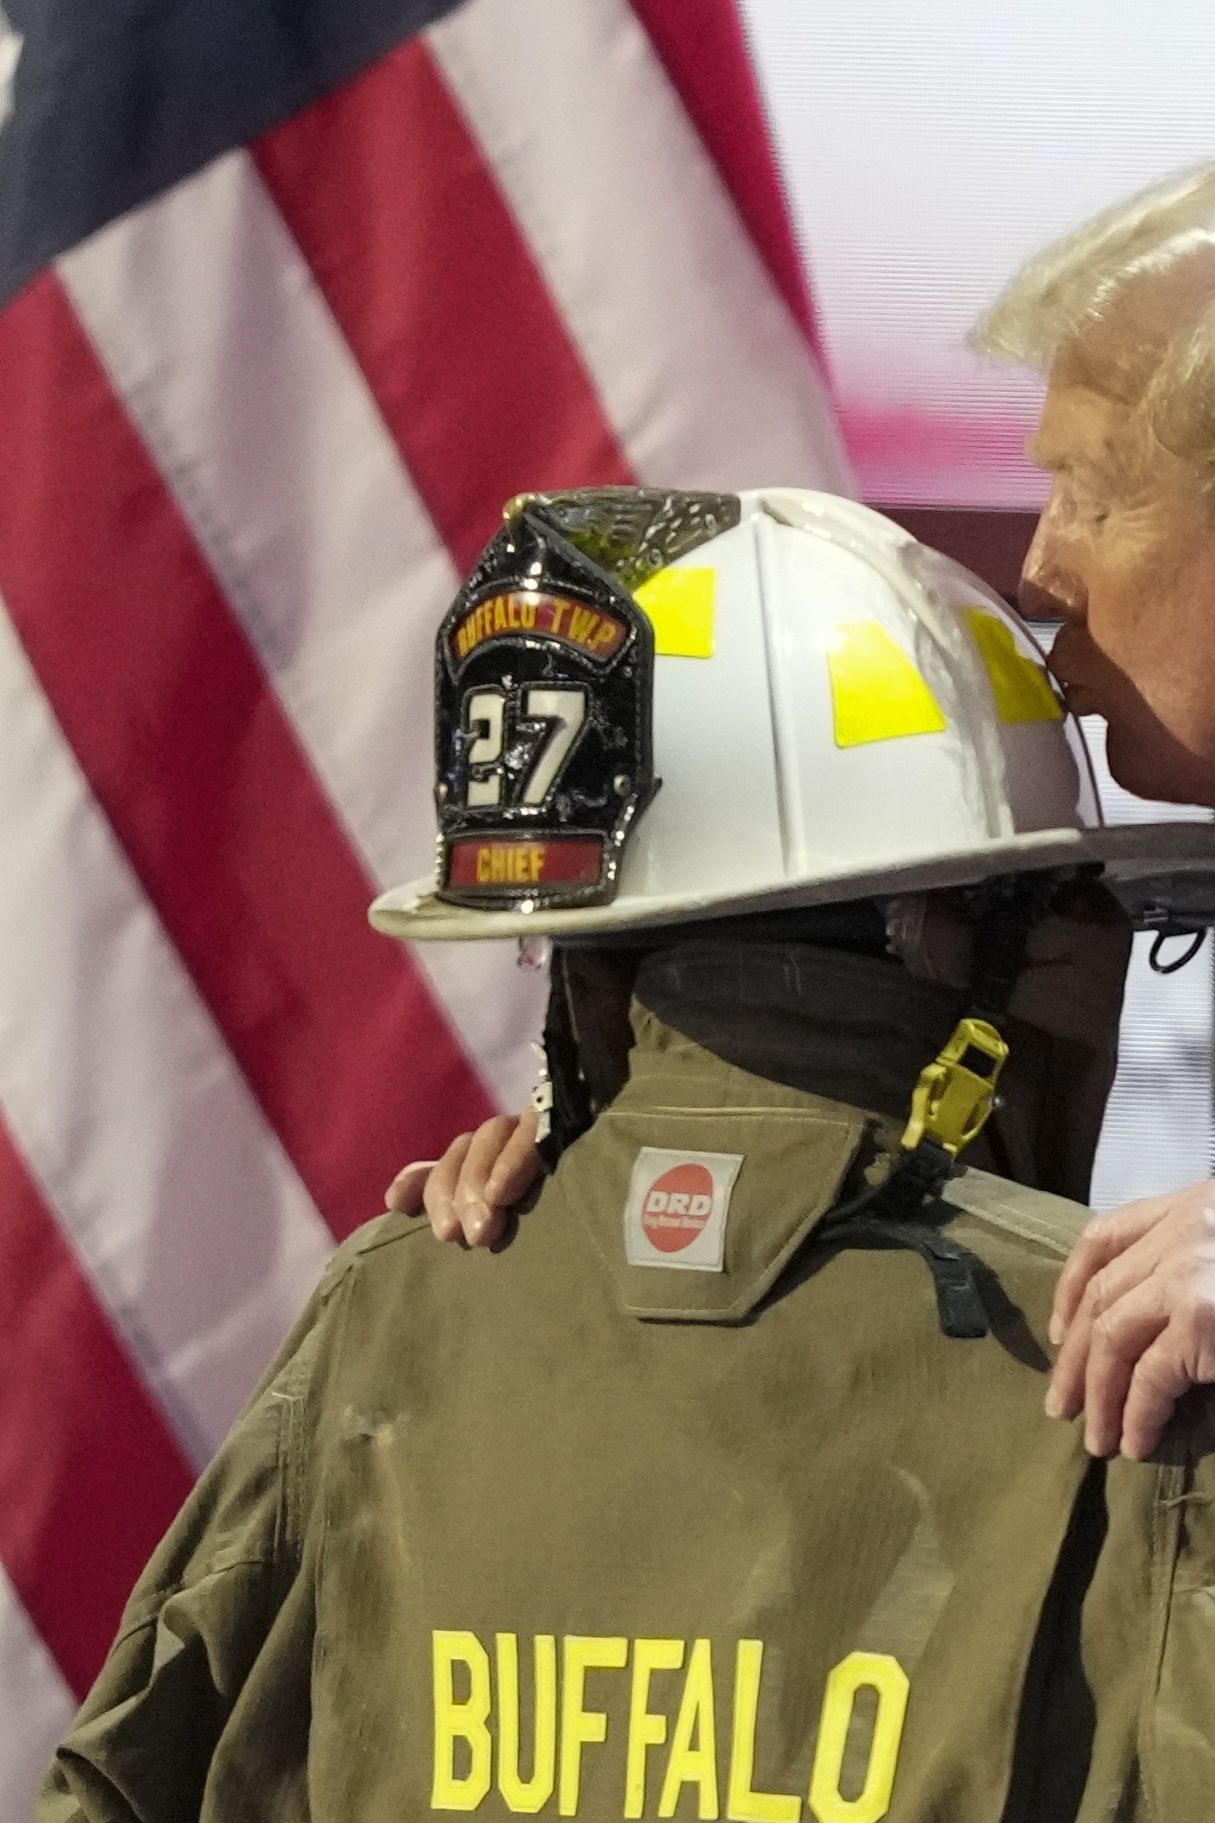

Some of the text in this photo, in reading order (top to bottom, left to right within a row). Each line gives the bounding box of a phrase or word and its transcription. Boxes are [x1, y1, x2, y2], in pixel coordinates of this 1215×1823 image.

[457, 593, 536, 657] BUFFALO
[465, 687, 586, 808] 27
[475, 846, 546, 882] CHIEF
[646, 1191, 713, 1216] DRD
